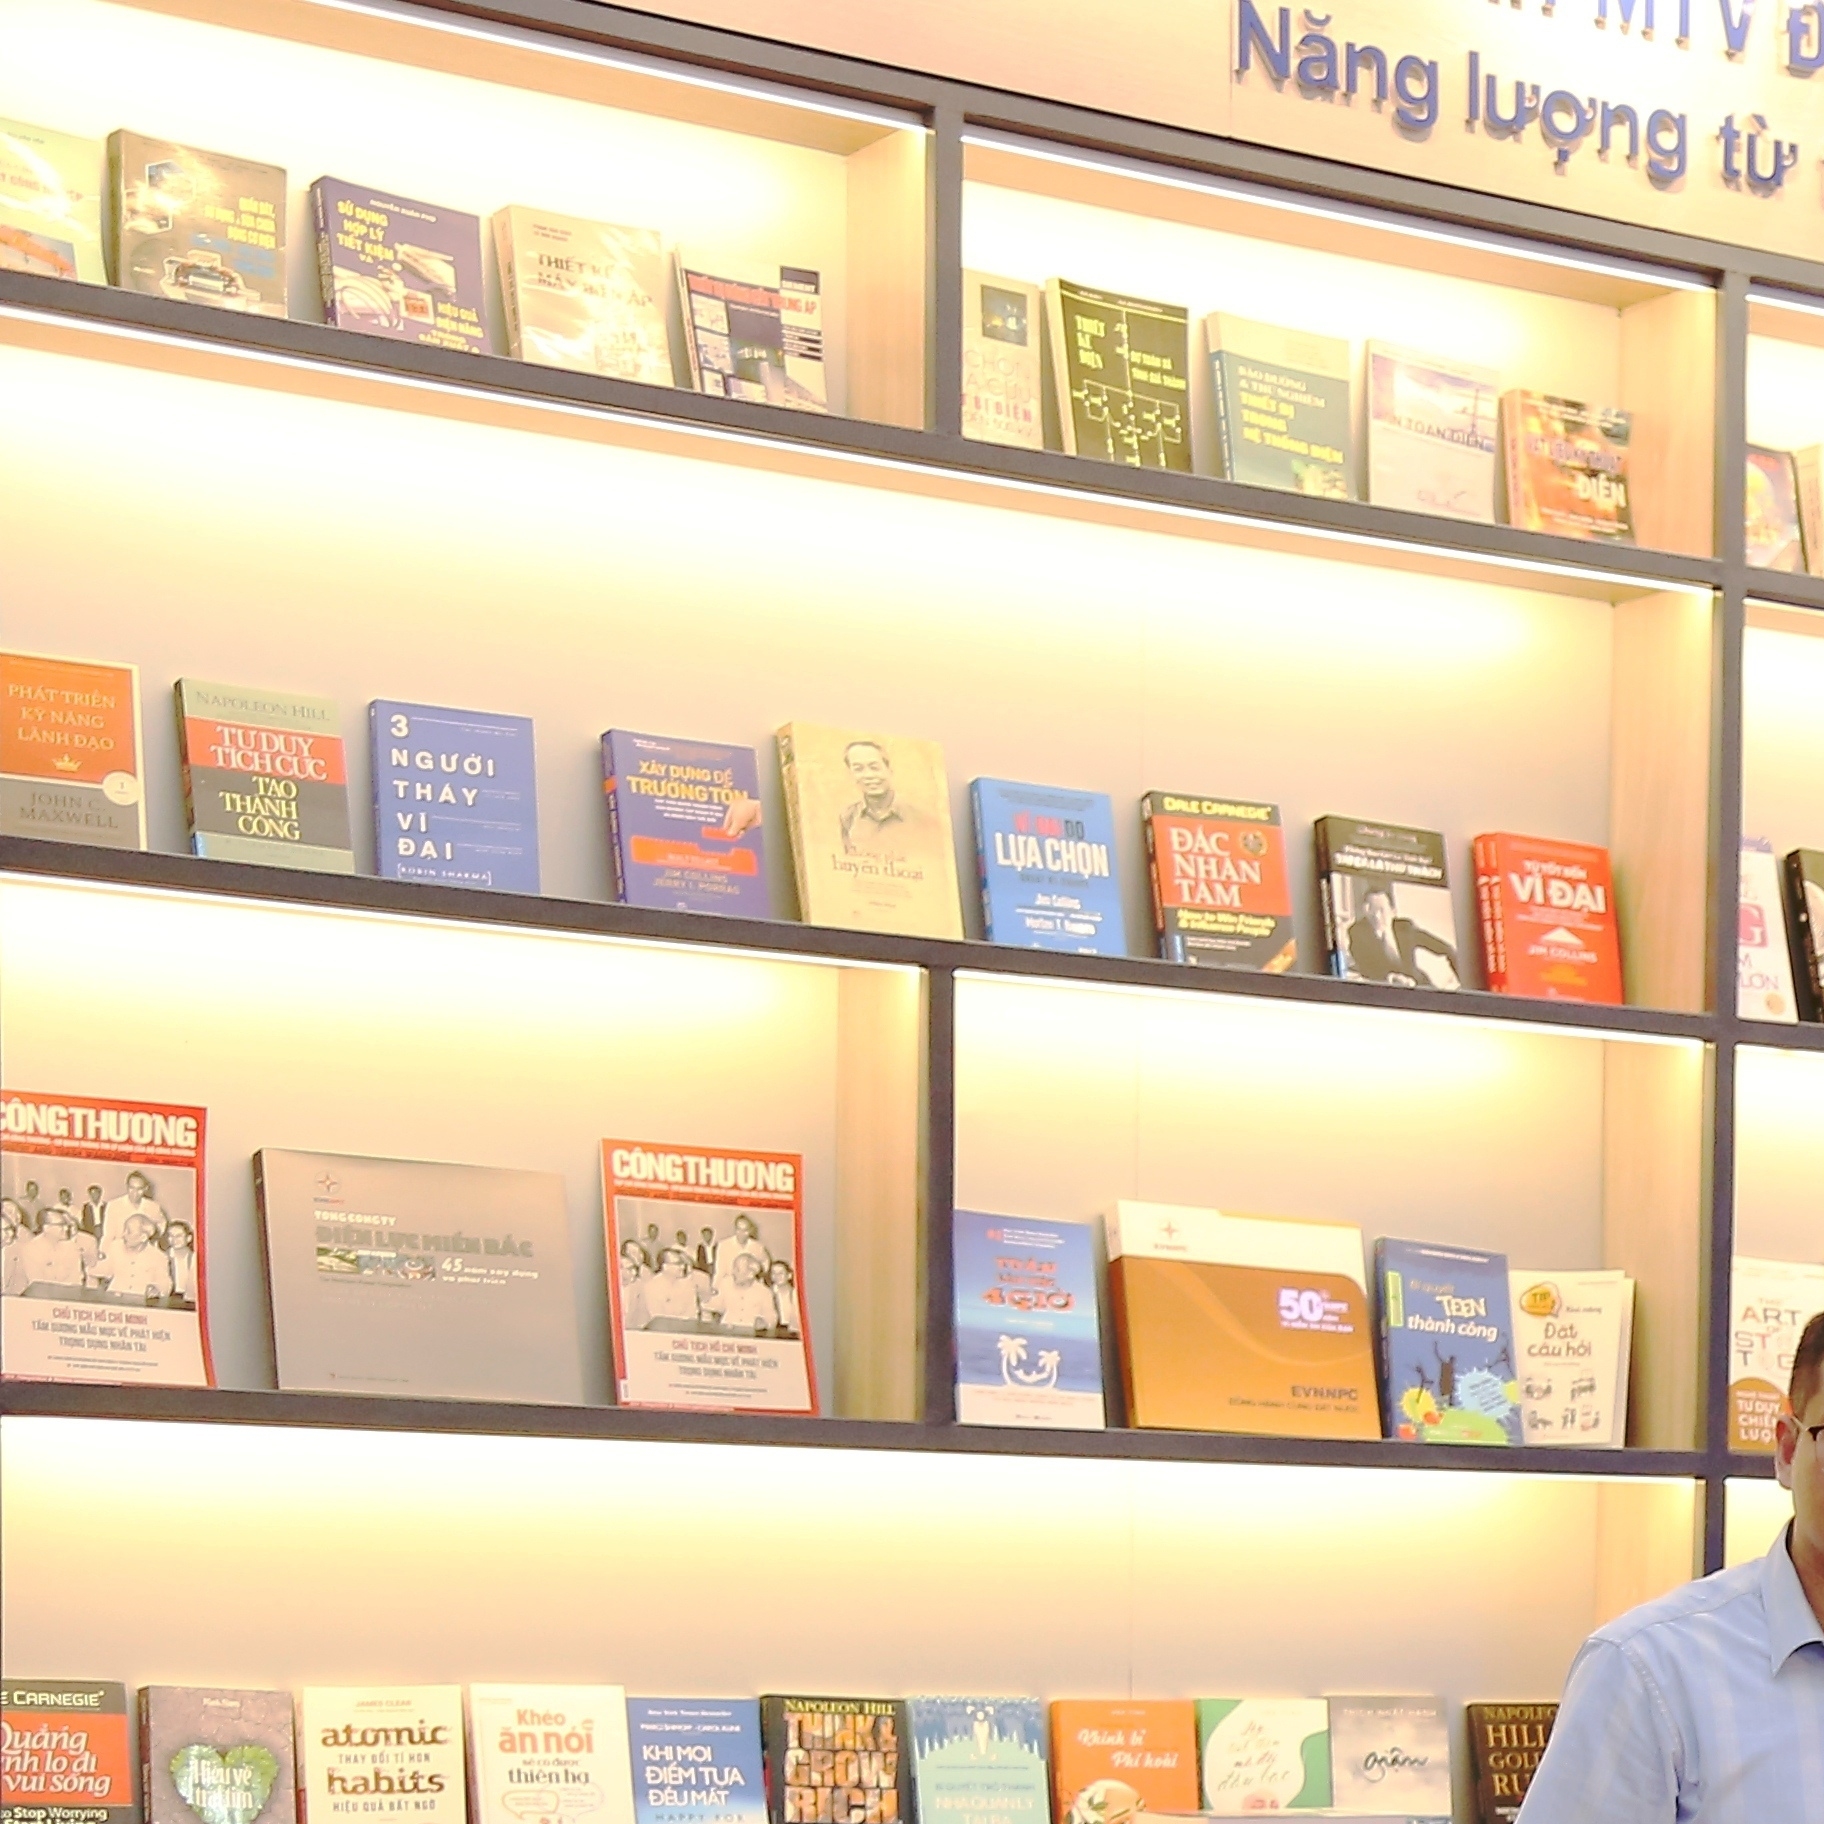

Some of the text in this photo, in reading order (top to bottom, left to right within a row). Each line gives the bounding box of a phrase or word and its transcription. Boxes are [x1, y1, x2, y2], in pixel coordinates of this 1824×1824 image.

[1237, 0, 1439, 130] Năng
[1465, 50, 1689, 180] lượng
[1716, 112, 1798, 186] từ
[389, 715, 410, 738] 3
[390, 748, 495, 778] NGƯỜI
[321, 1719, 452, 1747] atomic
[643, 1745, 674, 1760] KHI
[326, 1767, 448, 1795] habits
